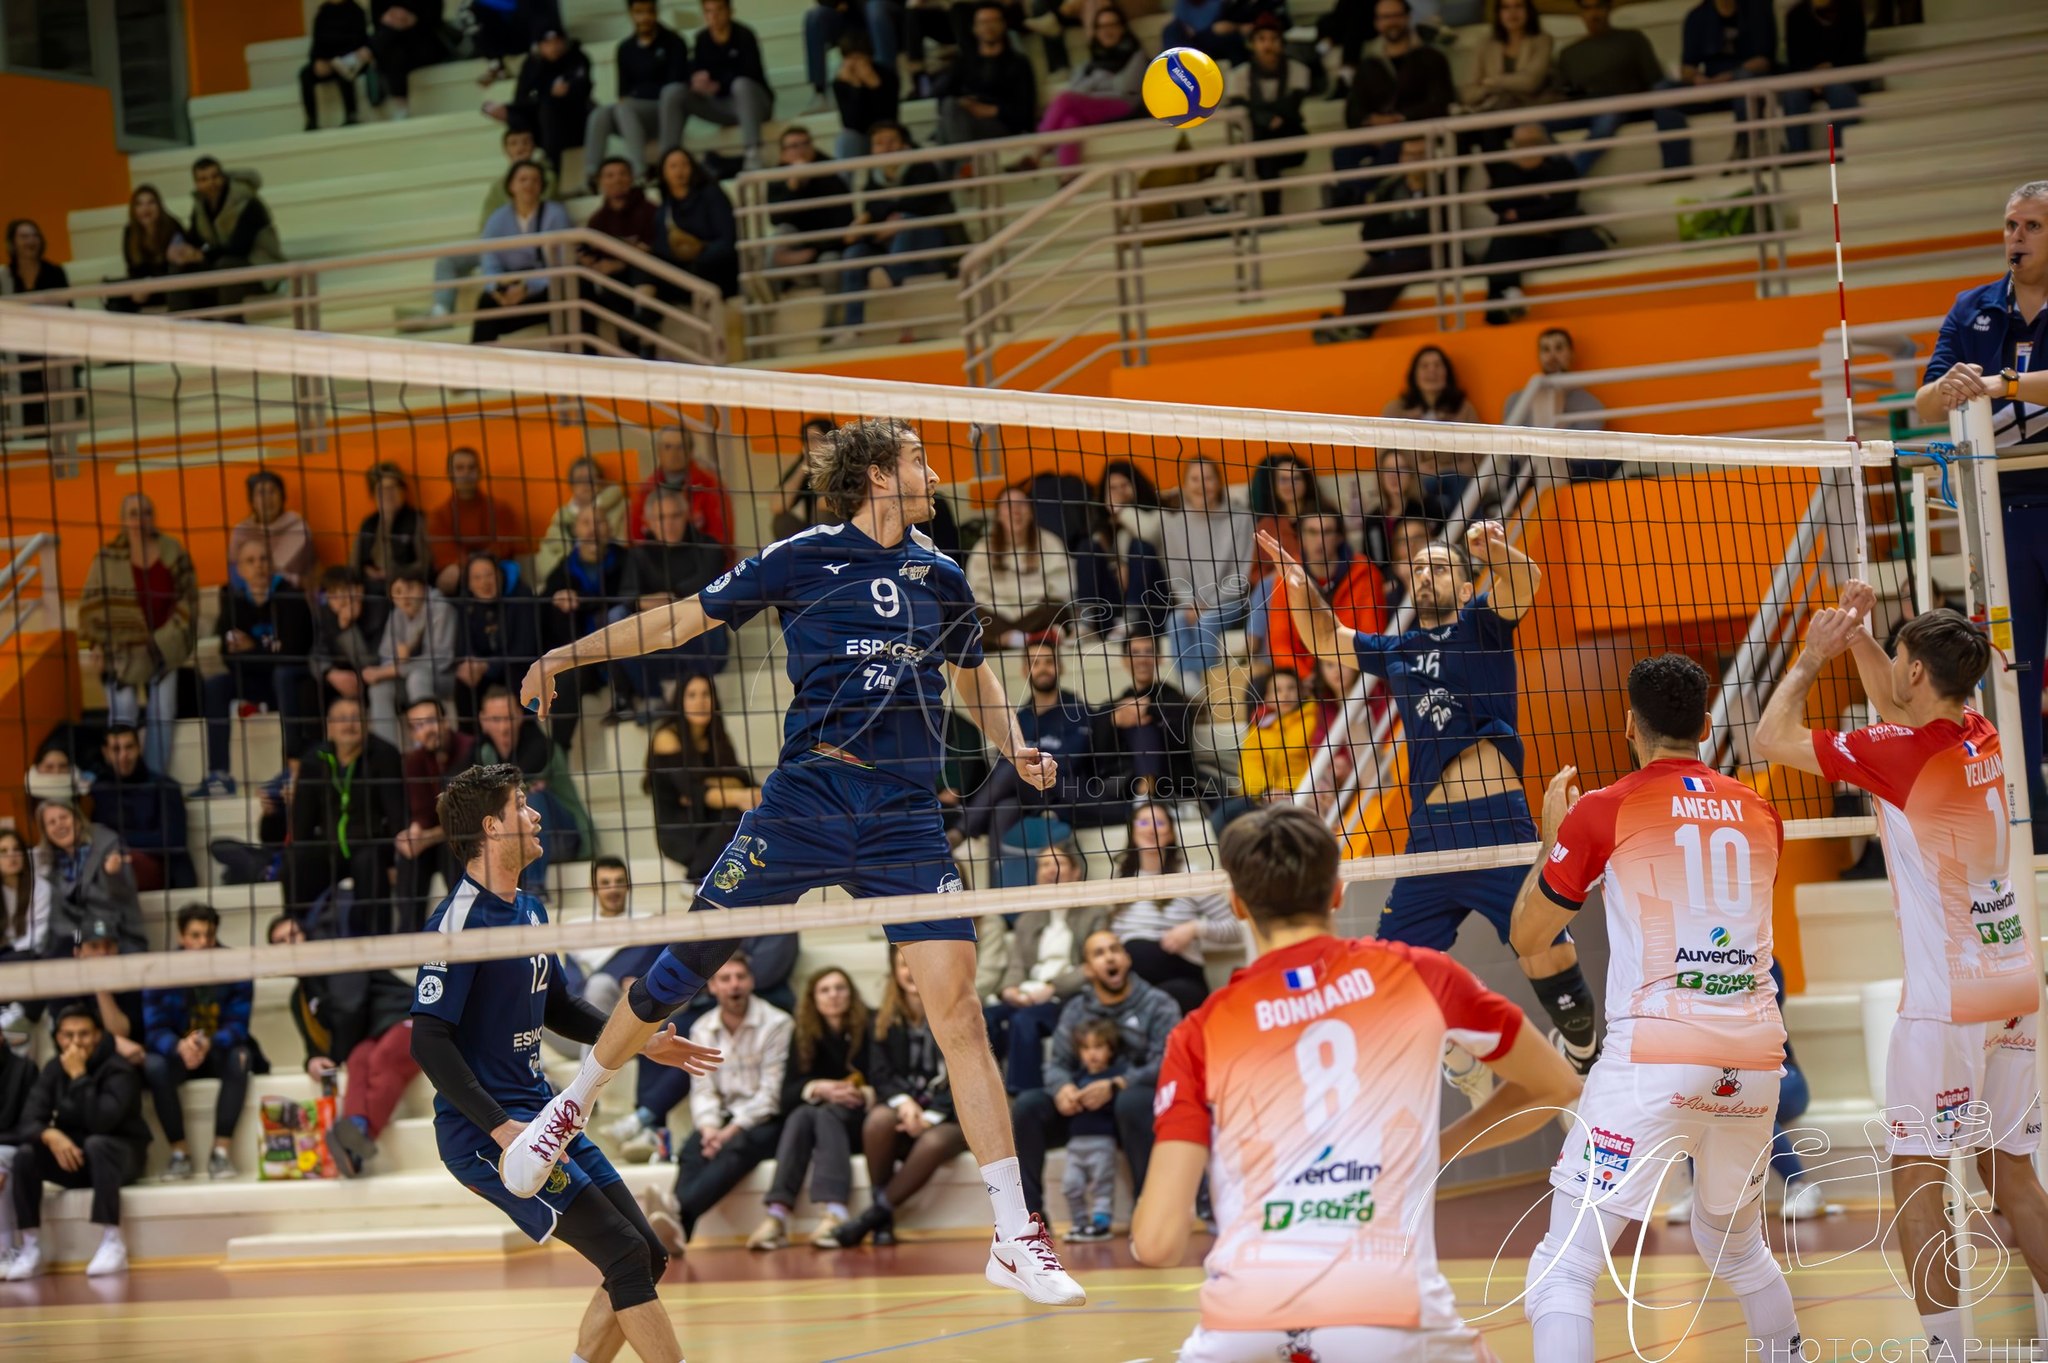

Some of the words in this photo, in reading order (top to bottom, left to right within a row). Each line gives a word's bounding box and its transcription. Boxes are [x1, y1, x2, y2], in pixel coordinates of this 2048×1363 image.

[871, 577, 900, 618] 9
[1671, 795, 1744, 822] ANEGAY
[1674, 823, 1752, 917] 10
[530, 953, 548, 994] 12
[1255, 967, 1376, 1032] BONNARD
[1295, 1018, 1361, 1136] 8
